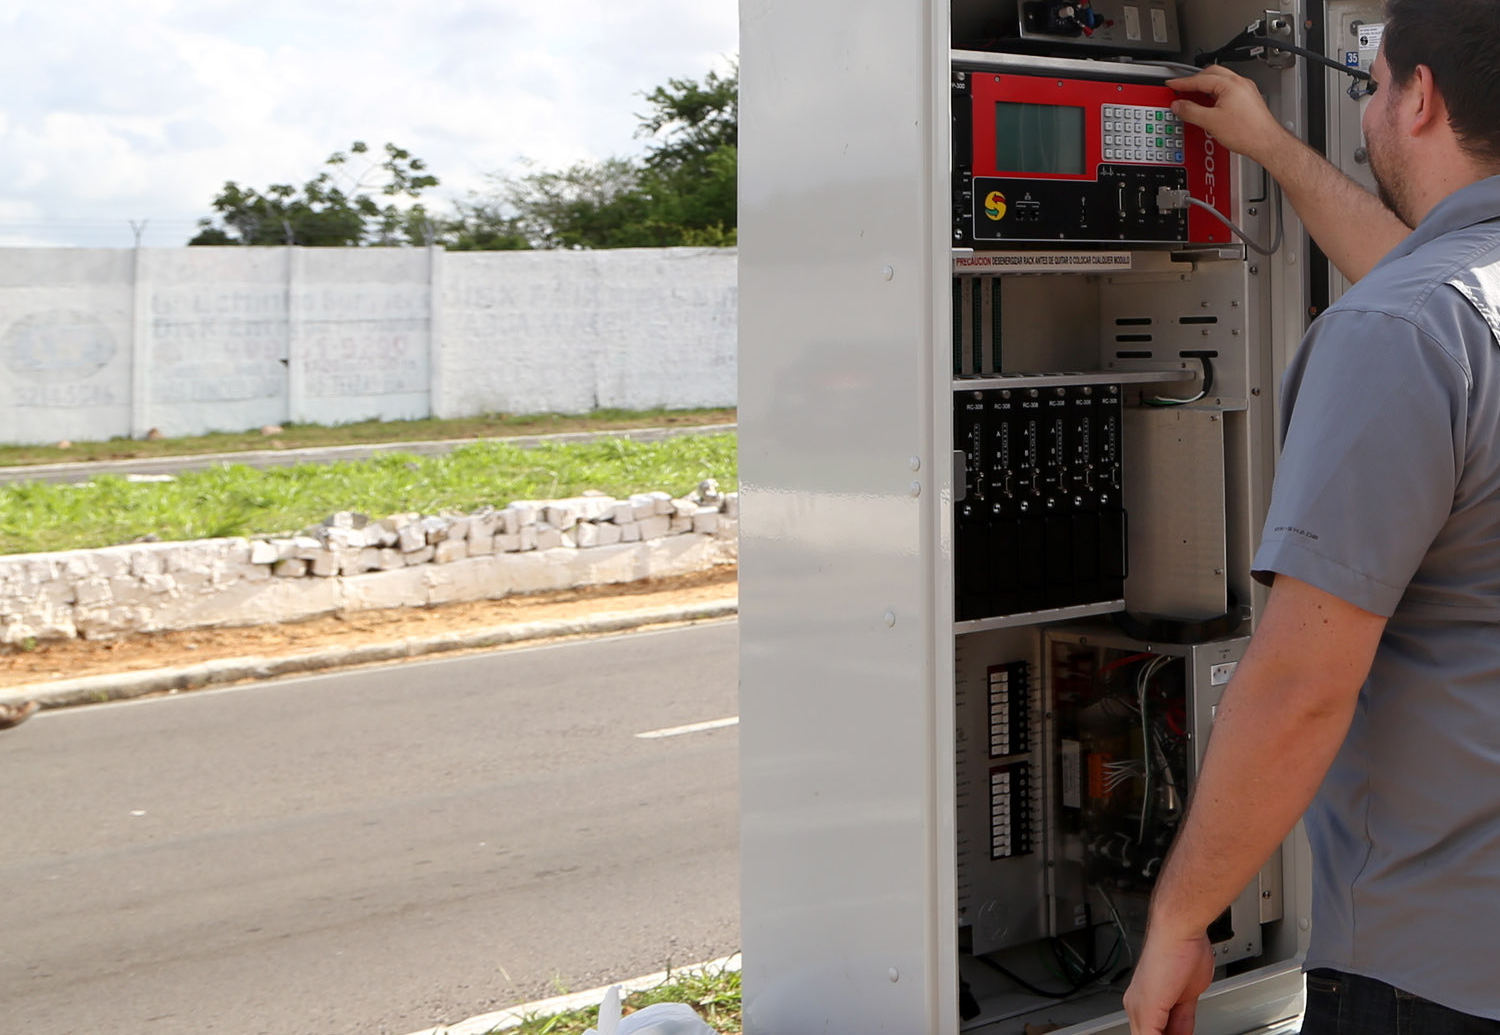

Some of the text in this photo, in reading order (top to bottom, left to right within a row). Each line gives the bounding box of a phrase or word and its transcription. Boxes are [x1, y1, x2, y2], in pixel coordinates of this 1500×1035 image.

[1347, 52, 1357, 63] 35
[1035, 256, 1048, 264] ANTES
[1048, 256, 1055, 264] DE
[1055, 256, 1069, 264] QUITAR
[1073, 256, 1092, 264] COLOCAR
[1092, 256, 1113, 264] CUALQUIER
